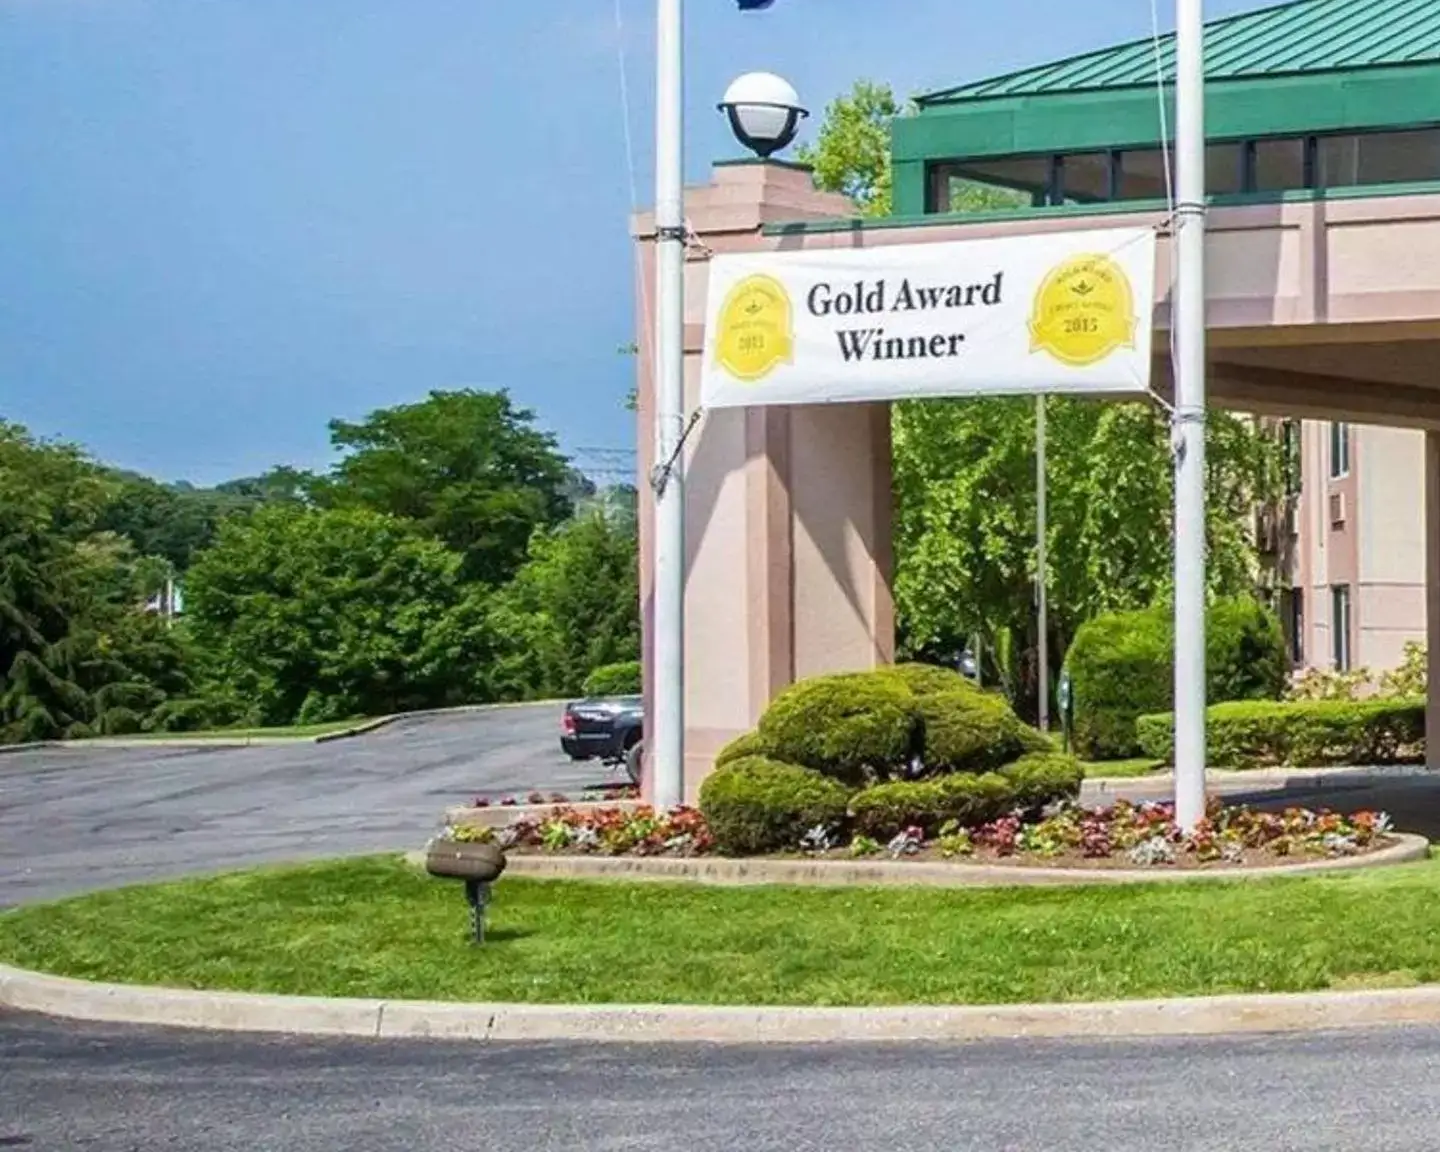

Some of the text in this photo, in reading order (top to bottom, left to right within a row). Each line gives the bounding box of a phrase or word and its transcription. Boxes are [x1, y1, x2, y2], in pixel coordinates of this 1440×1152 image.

[807, 279, 885, 317] Gold
[890, 272, 1004, 312] Award
[836, 328, 965, 362] Winner
